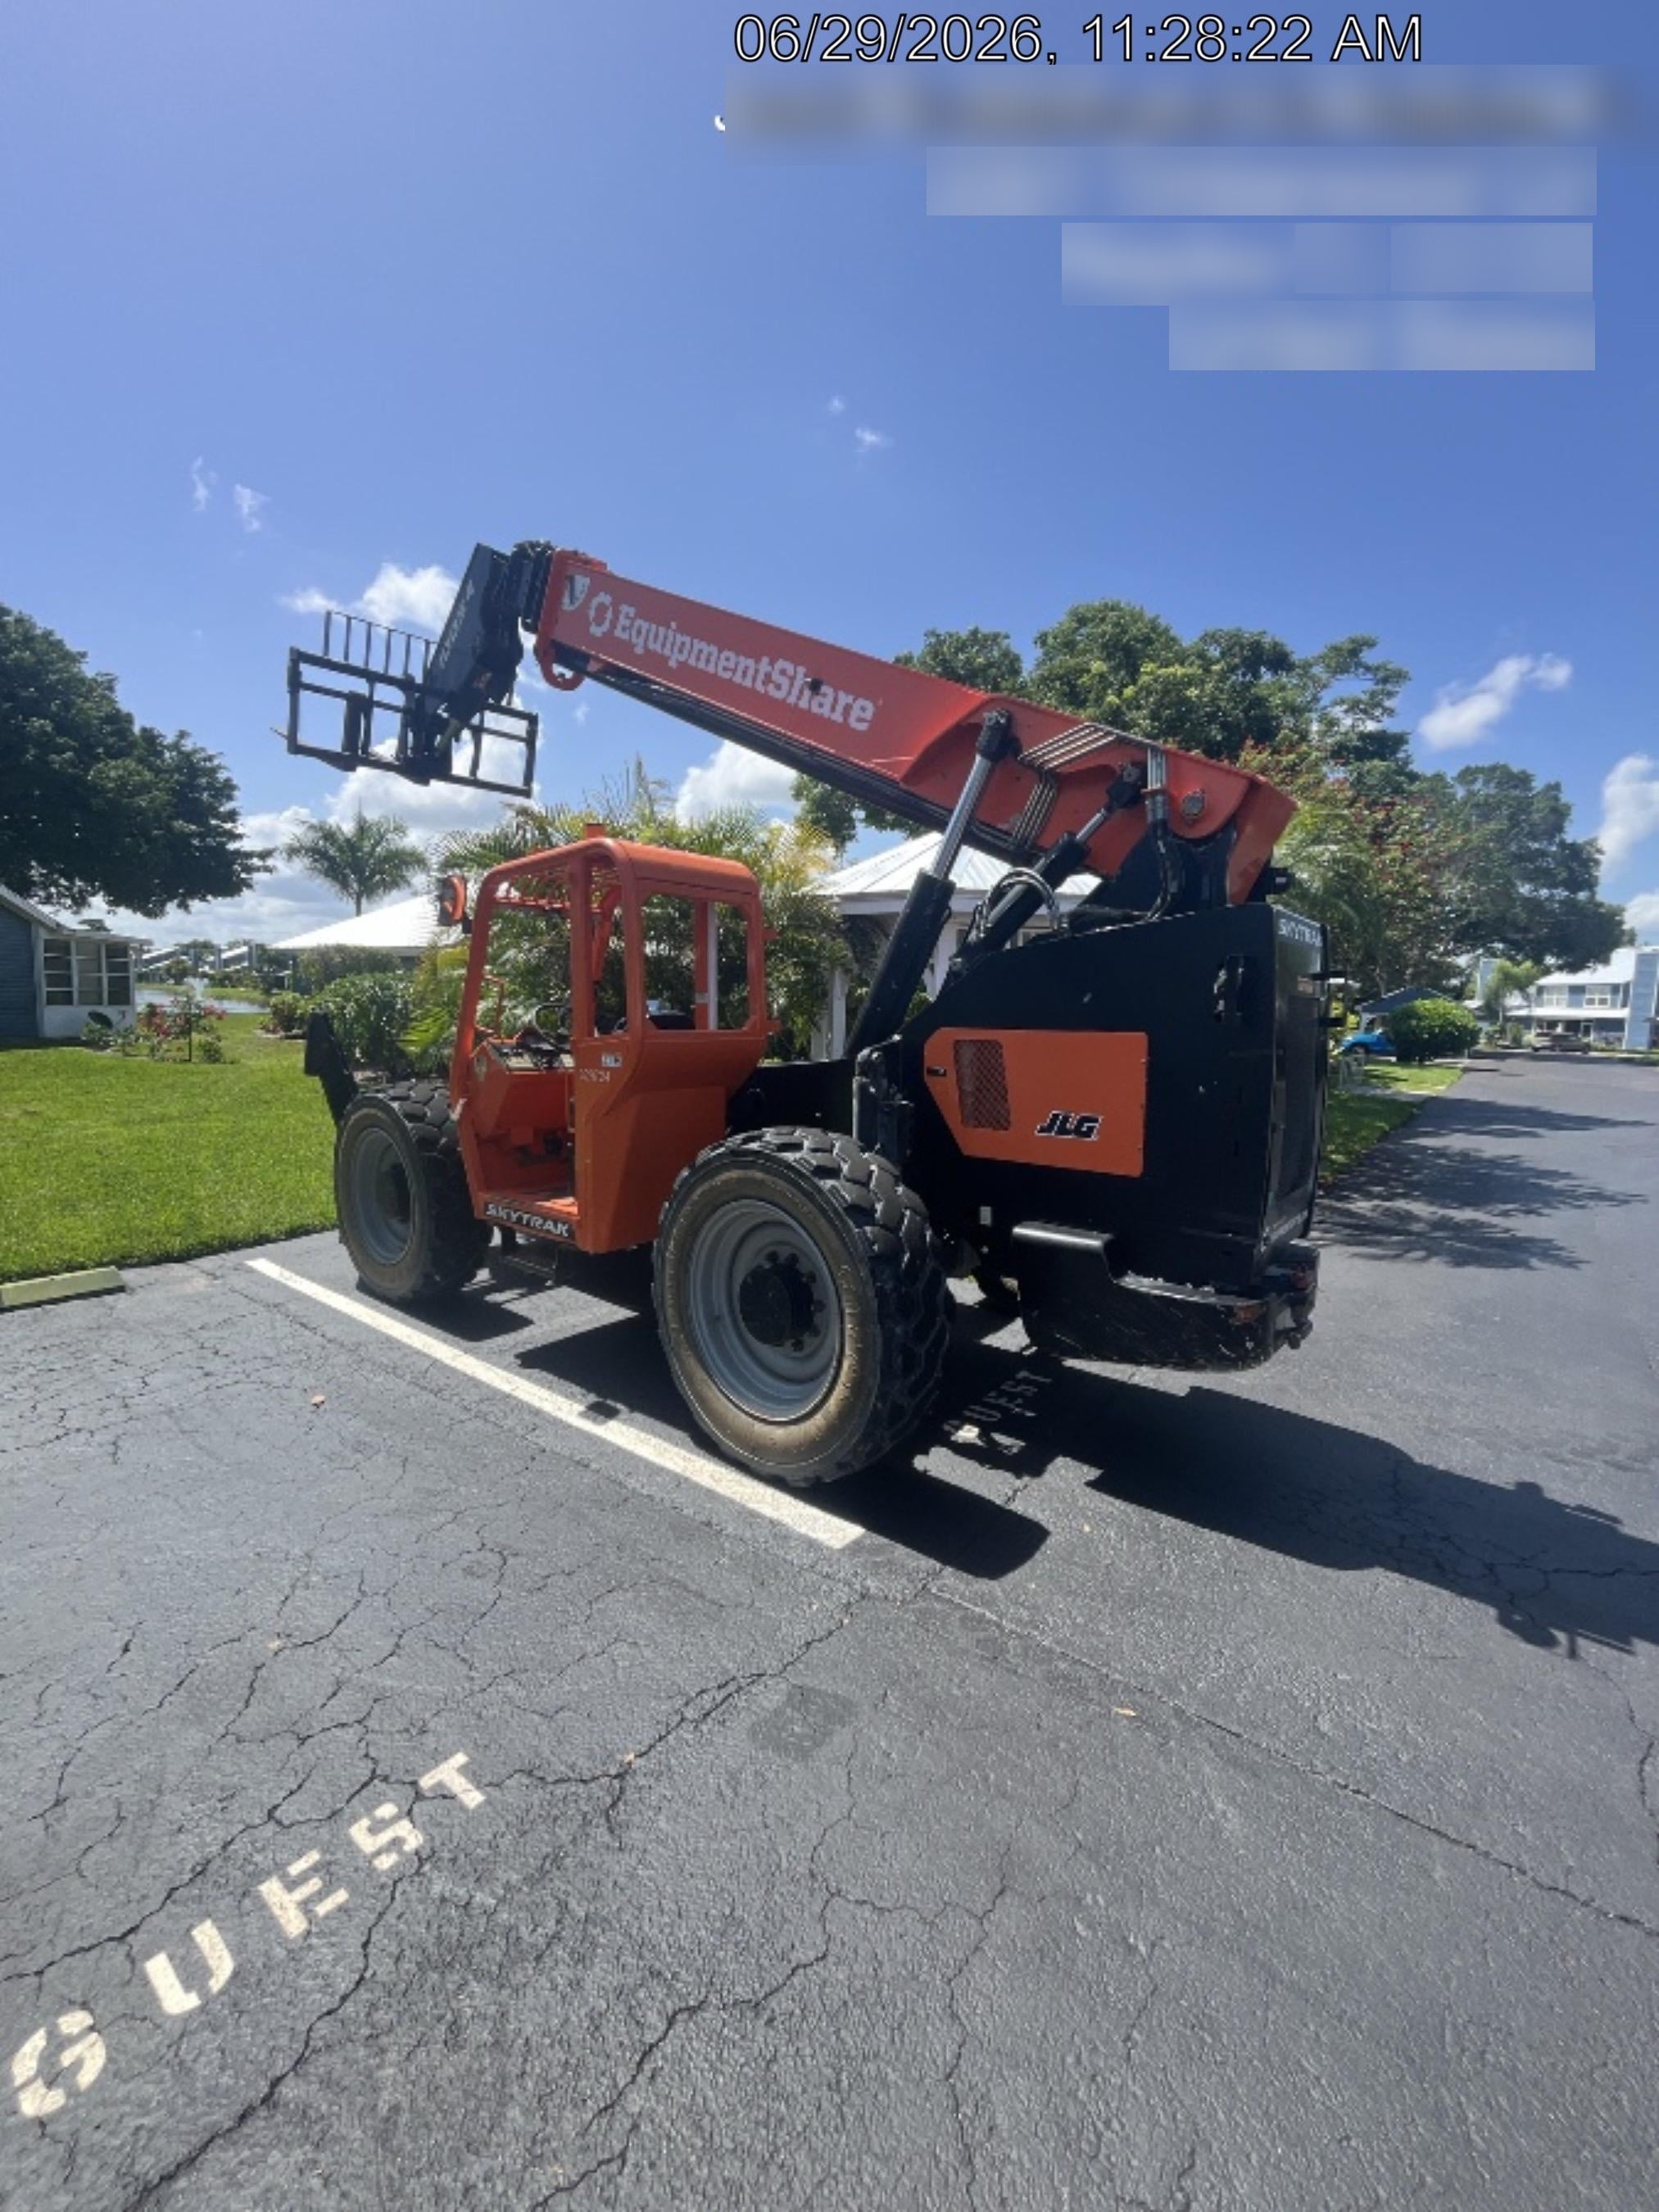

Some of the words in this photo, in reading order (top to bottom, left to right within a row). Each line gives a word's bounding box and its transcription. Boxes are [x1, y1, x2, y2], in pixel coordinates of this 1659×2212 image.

[614, 603, 877, 731] EquipmentShare
[1035, 1110, 1102, 1141] JLG
[486, 1203, 569, 1238] SKYTRAK
[11, 1751, 487, 2119] GUEST
